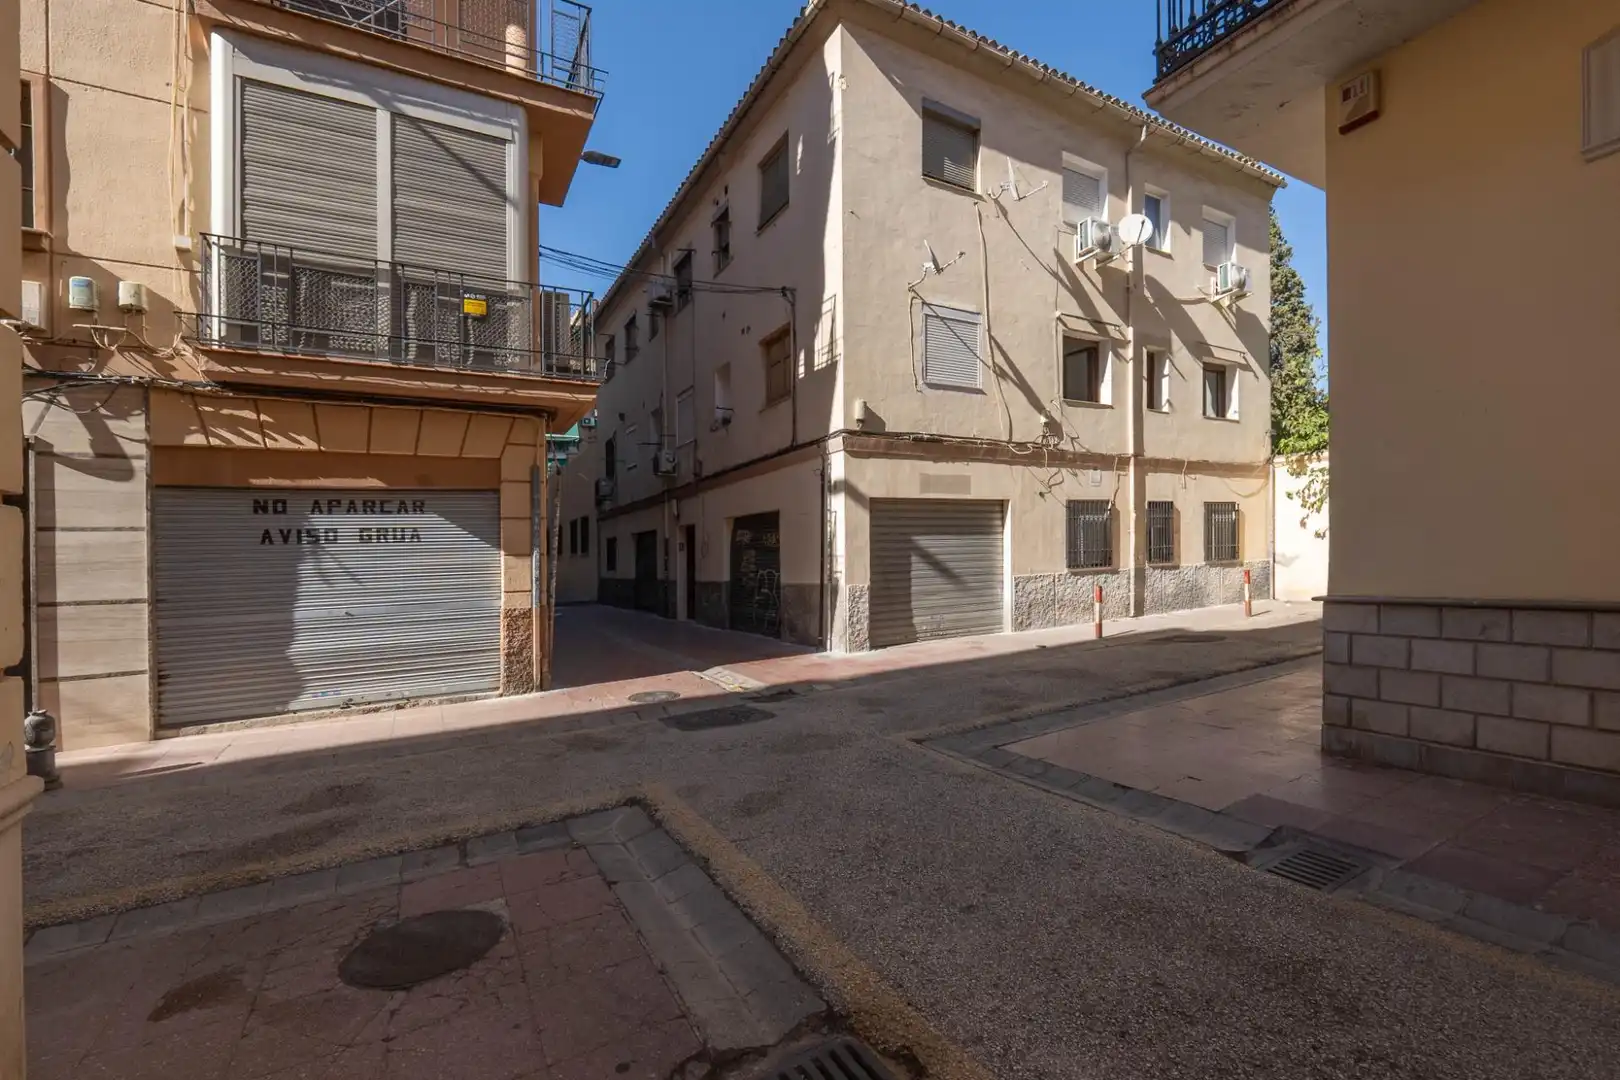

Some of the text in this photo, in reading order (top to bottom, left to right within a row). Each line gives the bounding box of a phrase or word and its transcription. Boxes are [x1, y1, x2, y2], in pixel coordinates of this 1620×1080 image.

[253, 499, 426, 514] NO APARCAR
[260, 527, 422, 545] AVISO GRUA
